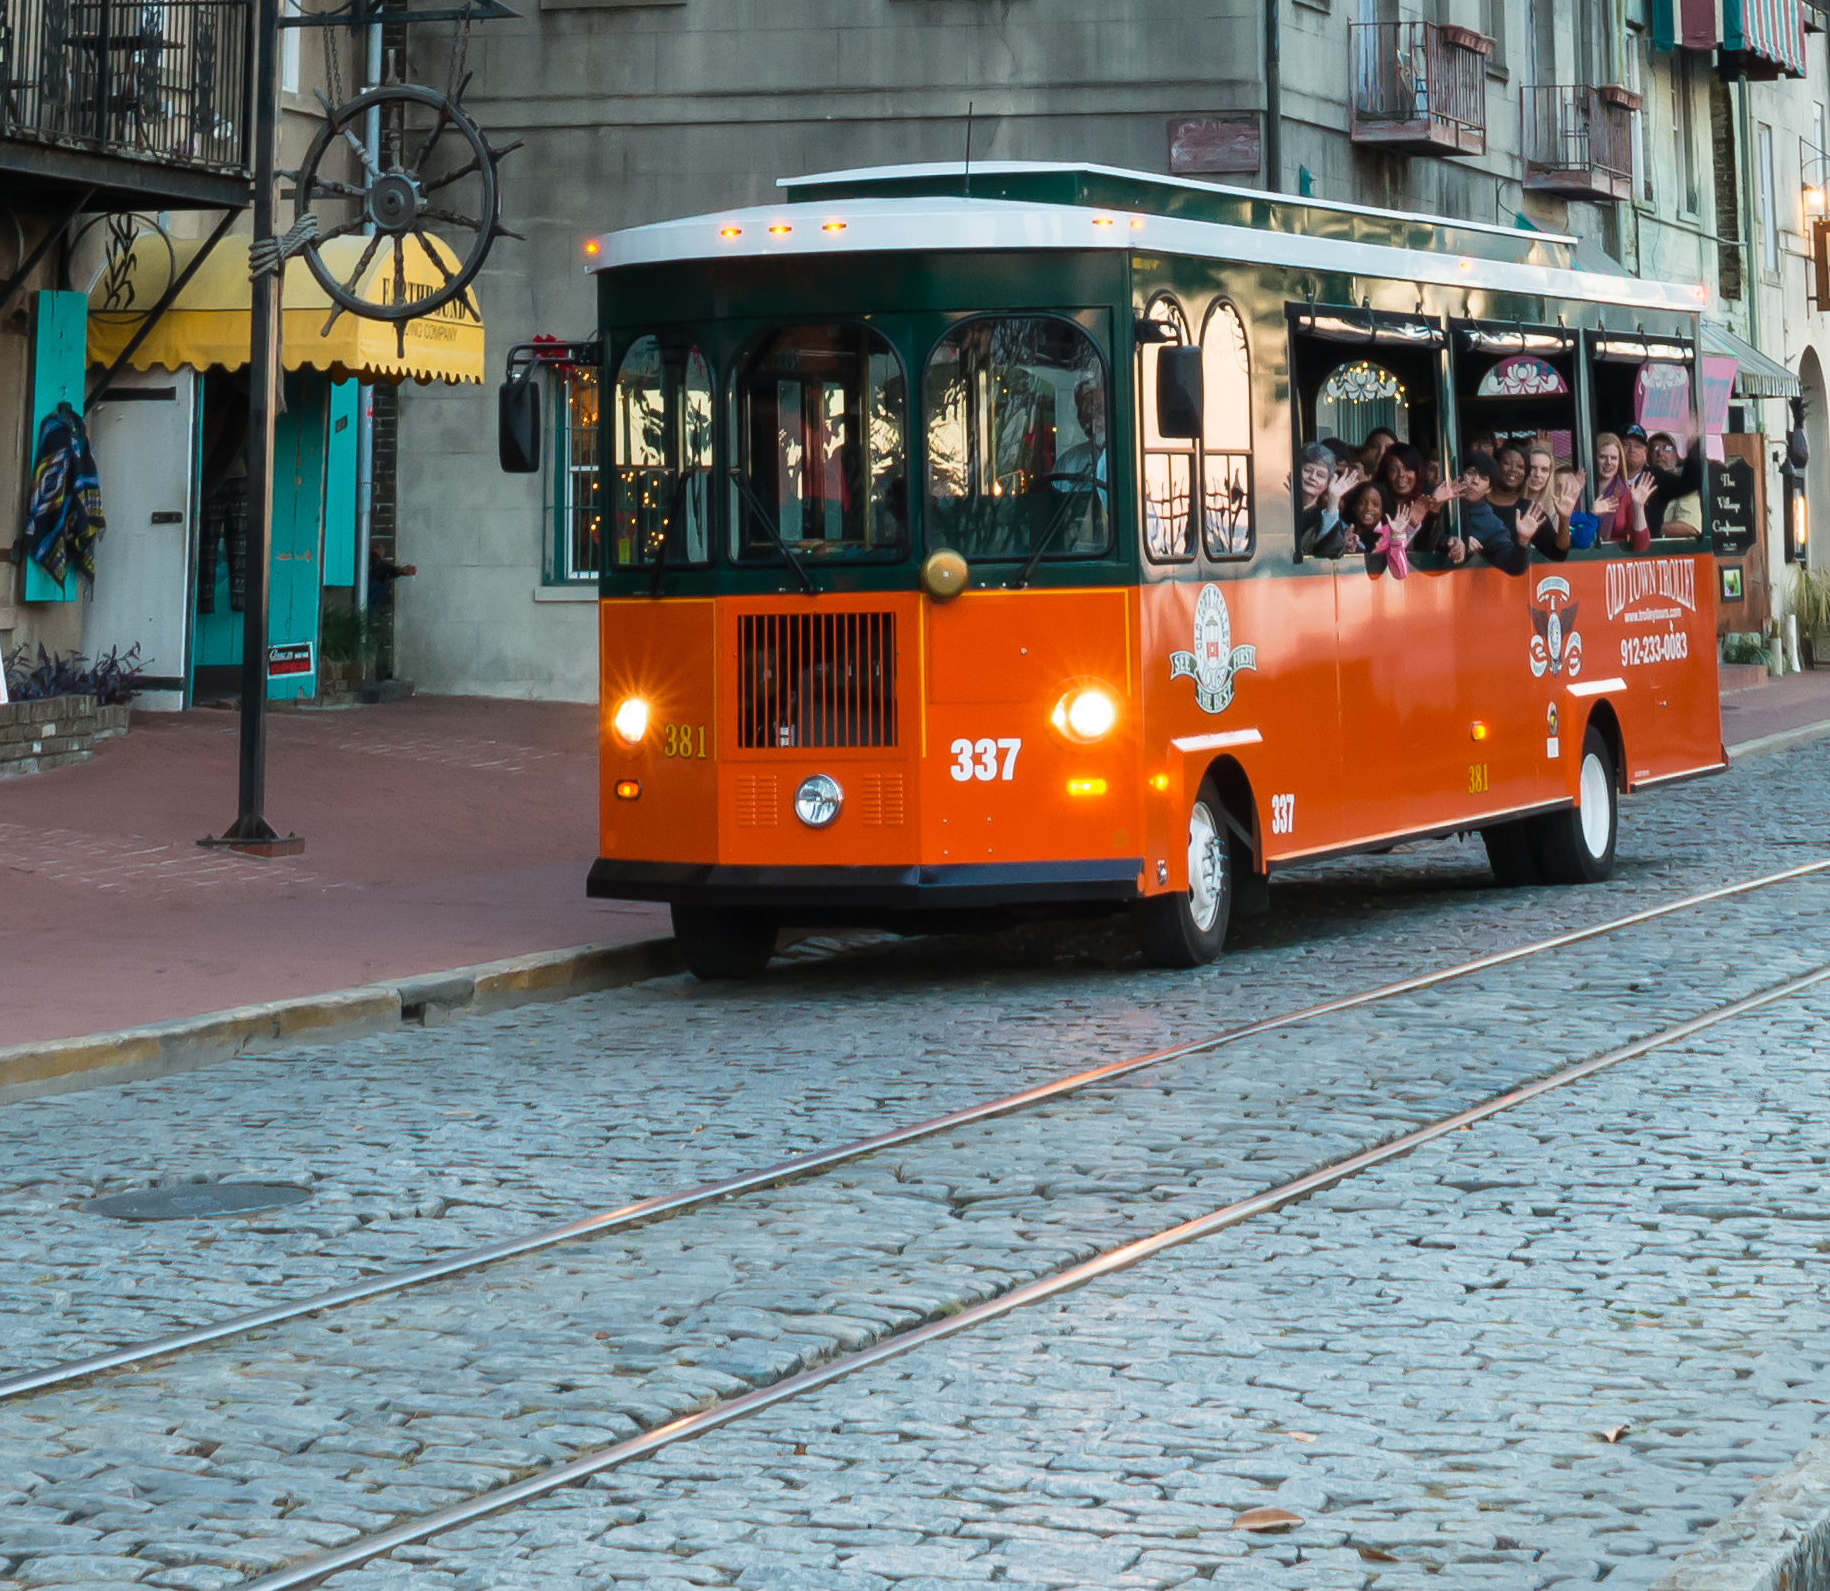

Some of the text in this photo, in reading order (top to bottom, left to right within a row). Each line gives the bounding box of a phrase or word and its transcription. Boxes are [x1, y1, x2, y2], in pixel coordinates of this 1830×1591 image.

[1605, 563, 1627, 621] OLD
[1626, 560, 1657, 604] TOWN
[1656, 558, 1697, 613] TROLLEY
[1174, 653, 1191, 673] SEE
[1620, 631, 1688, 667] 912-233-0083
[663, 723, 708, 759] 381
[949, 738, 1022, 782] 337
[1467, 763, 1489, 794] 381
[1271, 793, 1295, 835] 337
